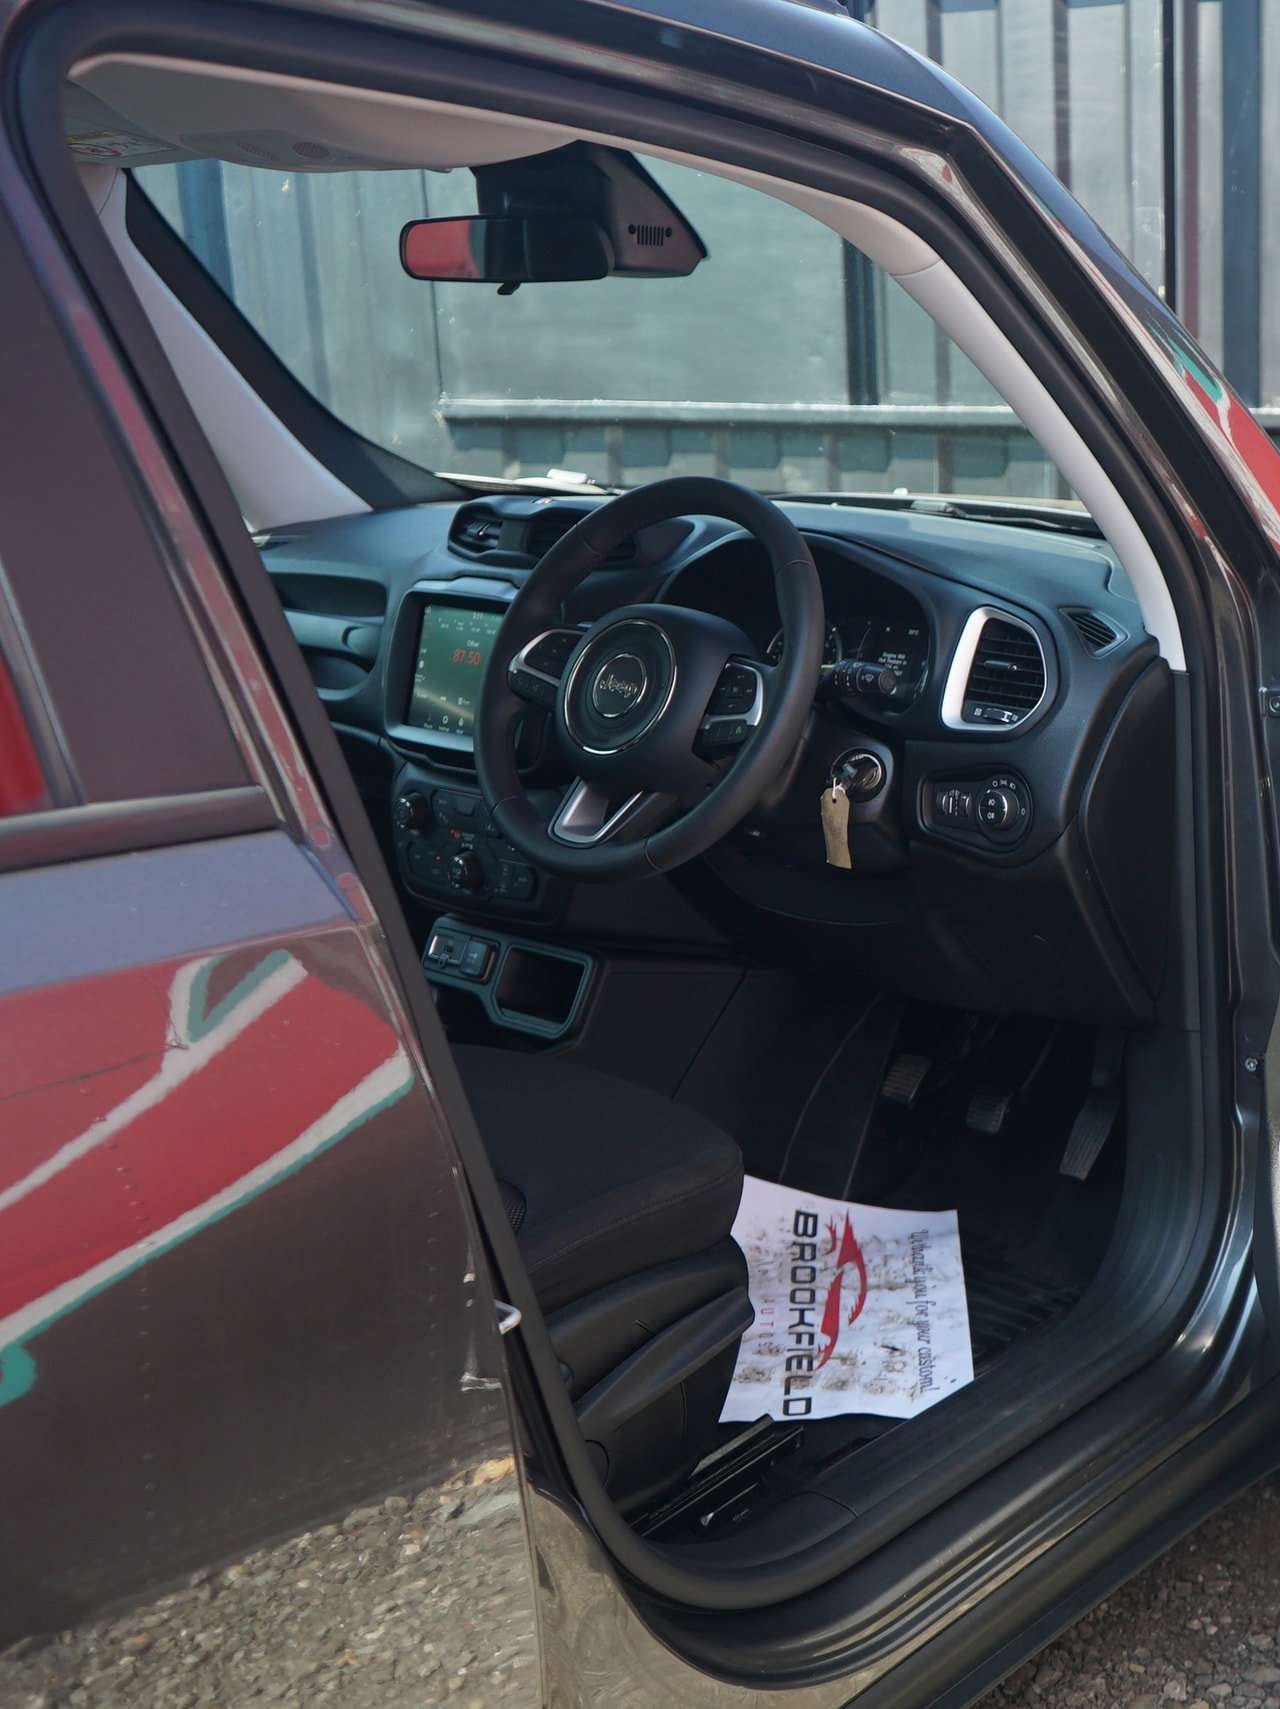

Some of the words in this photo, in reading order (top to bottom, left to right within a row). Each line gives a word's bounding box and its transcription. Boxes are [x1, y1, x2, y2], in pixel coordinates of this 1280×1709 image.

[600, 674, 638, 698] Jeep
[783, 1210, 818, 1416] BROOKFIELD
[906, 1300, 936, 1317] for
[908, 1320, 931, 1344] your
[917, 1347, 940, 1394] custom!
